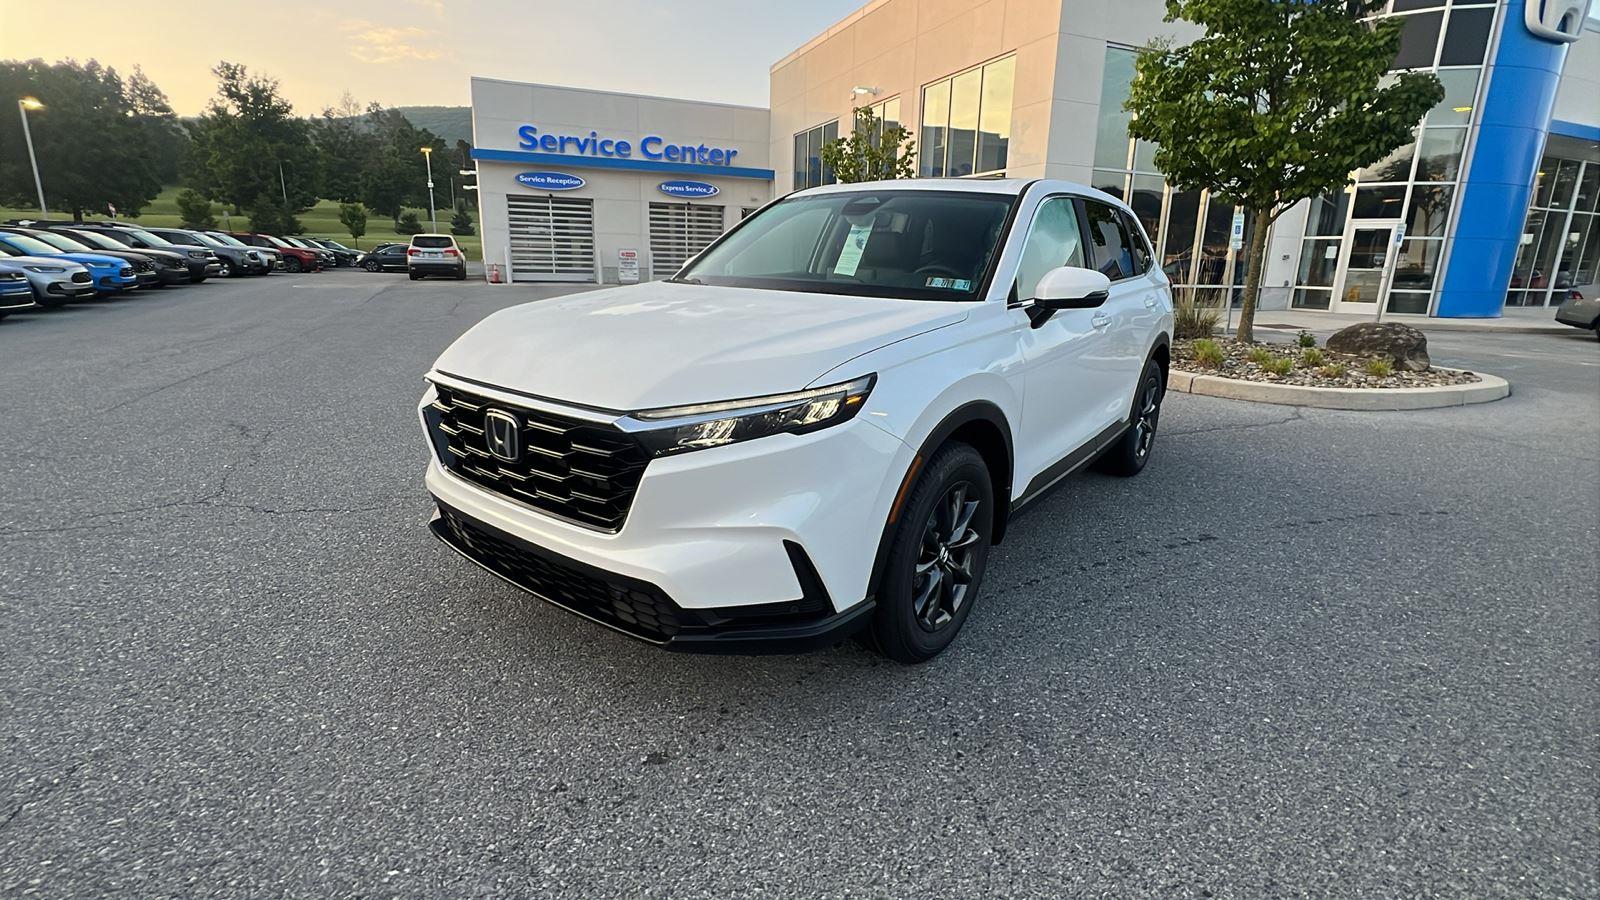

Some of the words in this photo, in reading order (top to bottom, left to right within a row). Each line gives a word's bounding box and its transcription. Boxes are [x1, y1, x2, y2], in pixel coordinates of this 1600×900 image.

[518, 125, 632, 157] Service
[640, 136, 738, 166] Center
[519, 175, 545, 183] Service
[546, 177, 581, 186] Reception
[661, 184, 685, 193] Express
